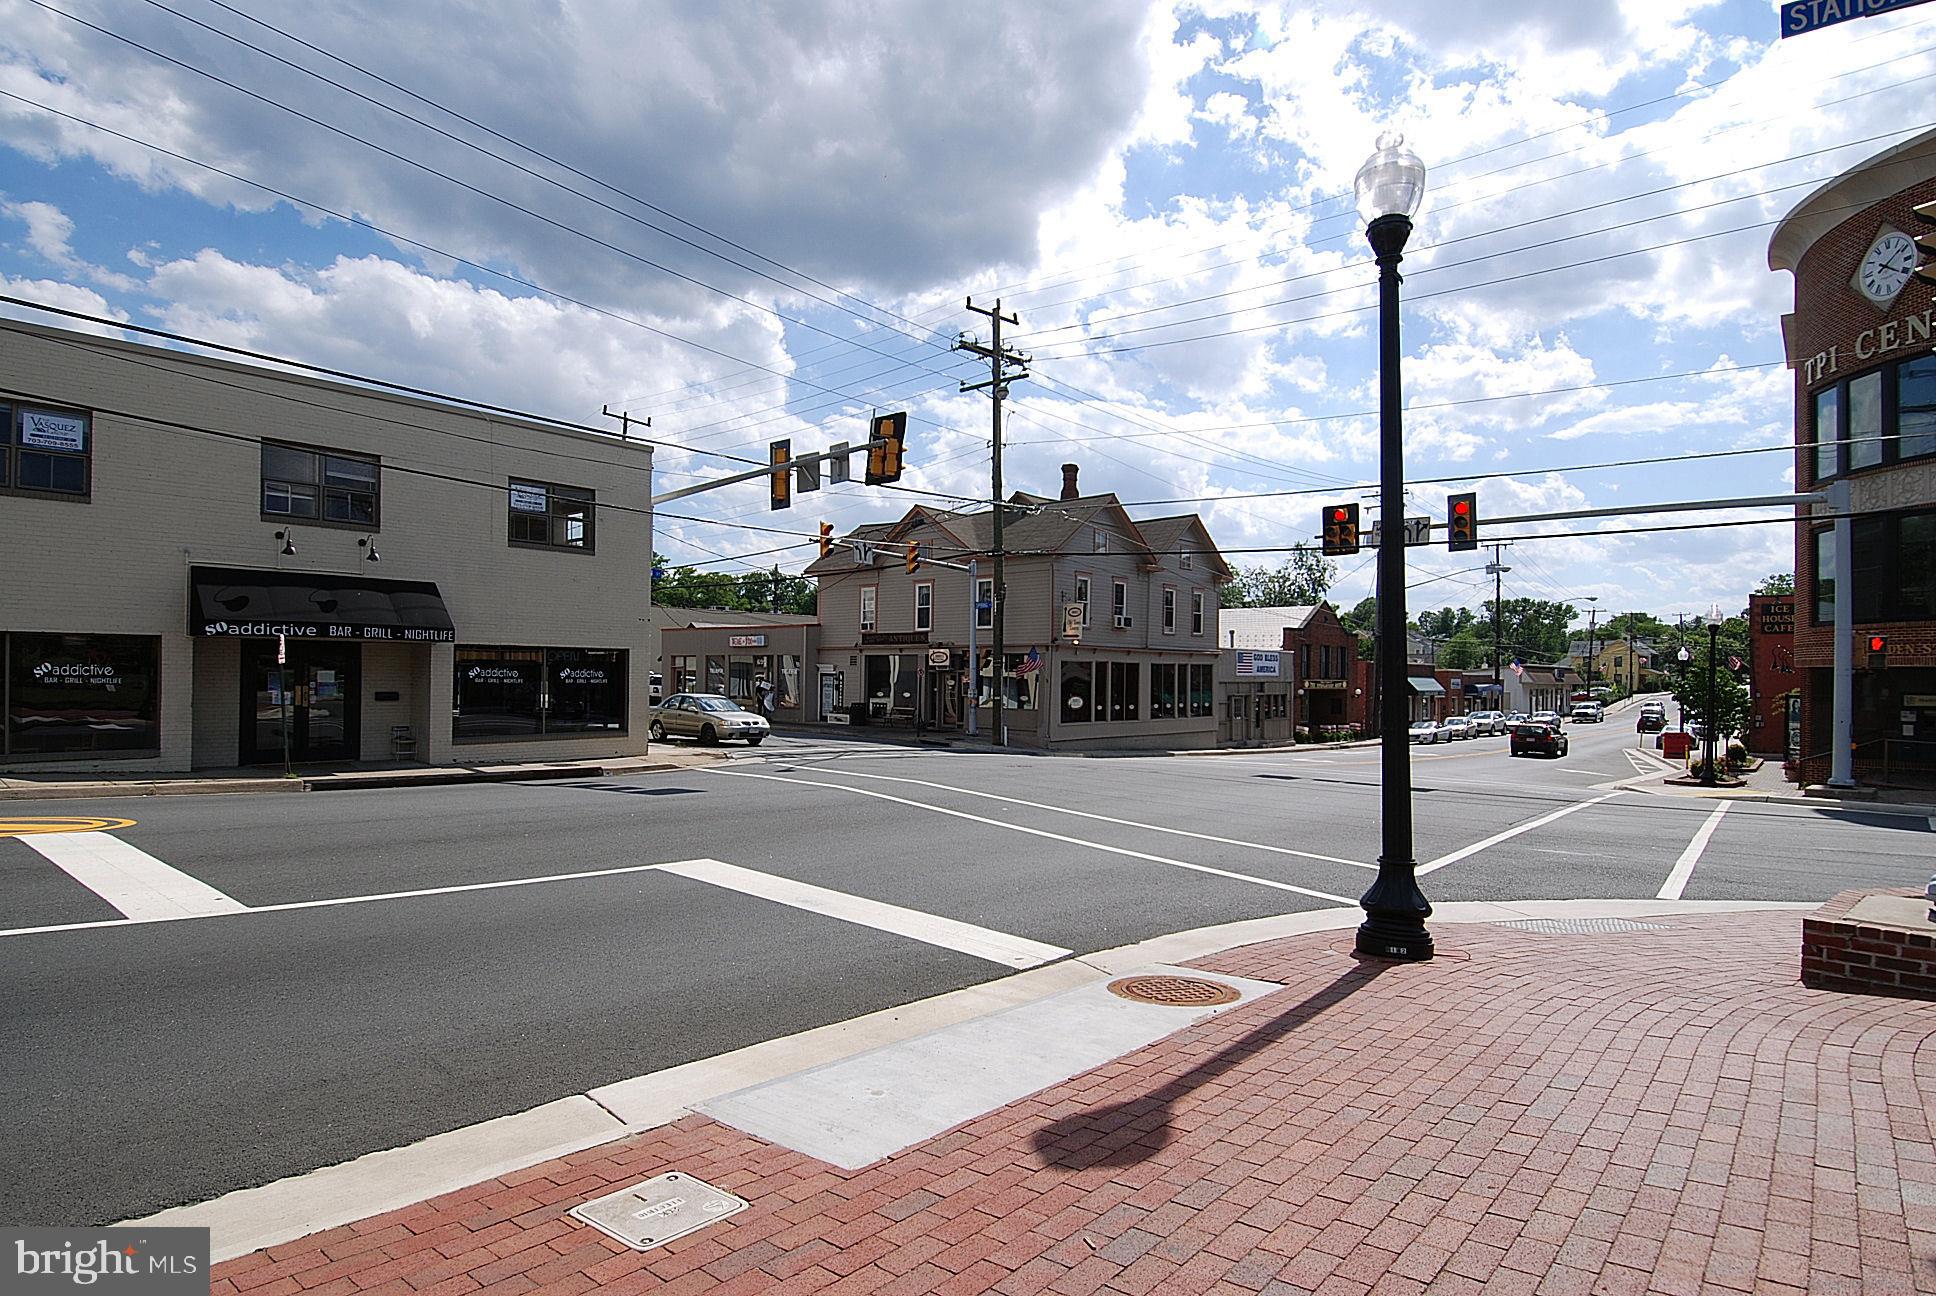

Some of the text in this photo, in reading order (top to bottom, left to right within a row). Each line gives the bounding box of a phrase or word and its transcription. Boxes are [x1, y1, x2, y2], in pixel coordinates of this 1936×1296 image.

[1804, 345, 1838, 386] TPI
[30, 416, 77, 433] VASQUEZ
[1770, 605, 1790, 613] ICE
[329, 626, 352, 637] BAR
[364, 627, 393, 639] GRILL
[404, 629, 454, 641] NIGHTLIFE
[1253, 653, 1279, 662] GOD BLESS
[1256, 665, 1276, 673] AMERICA
